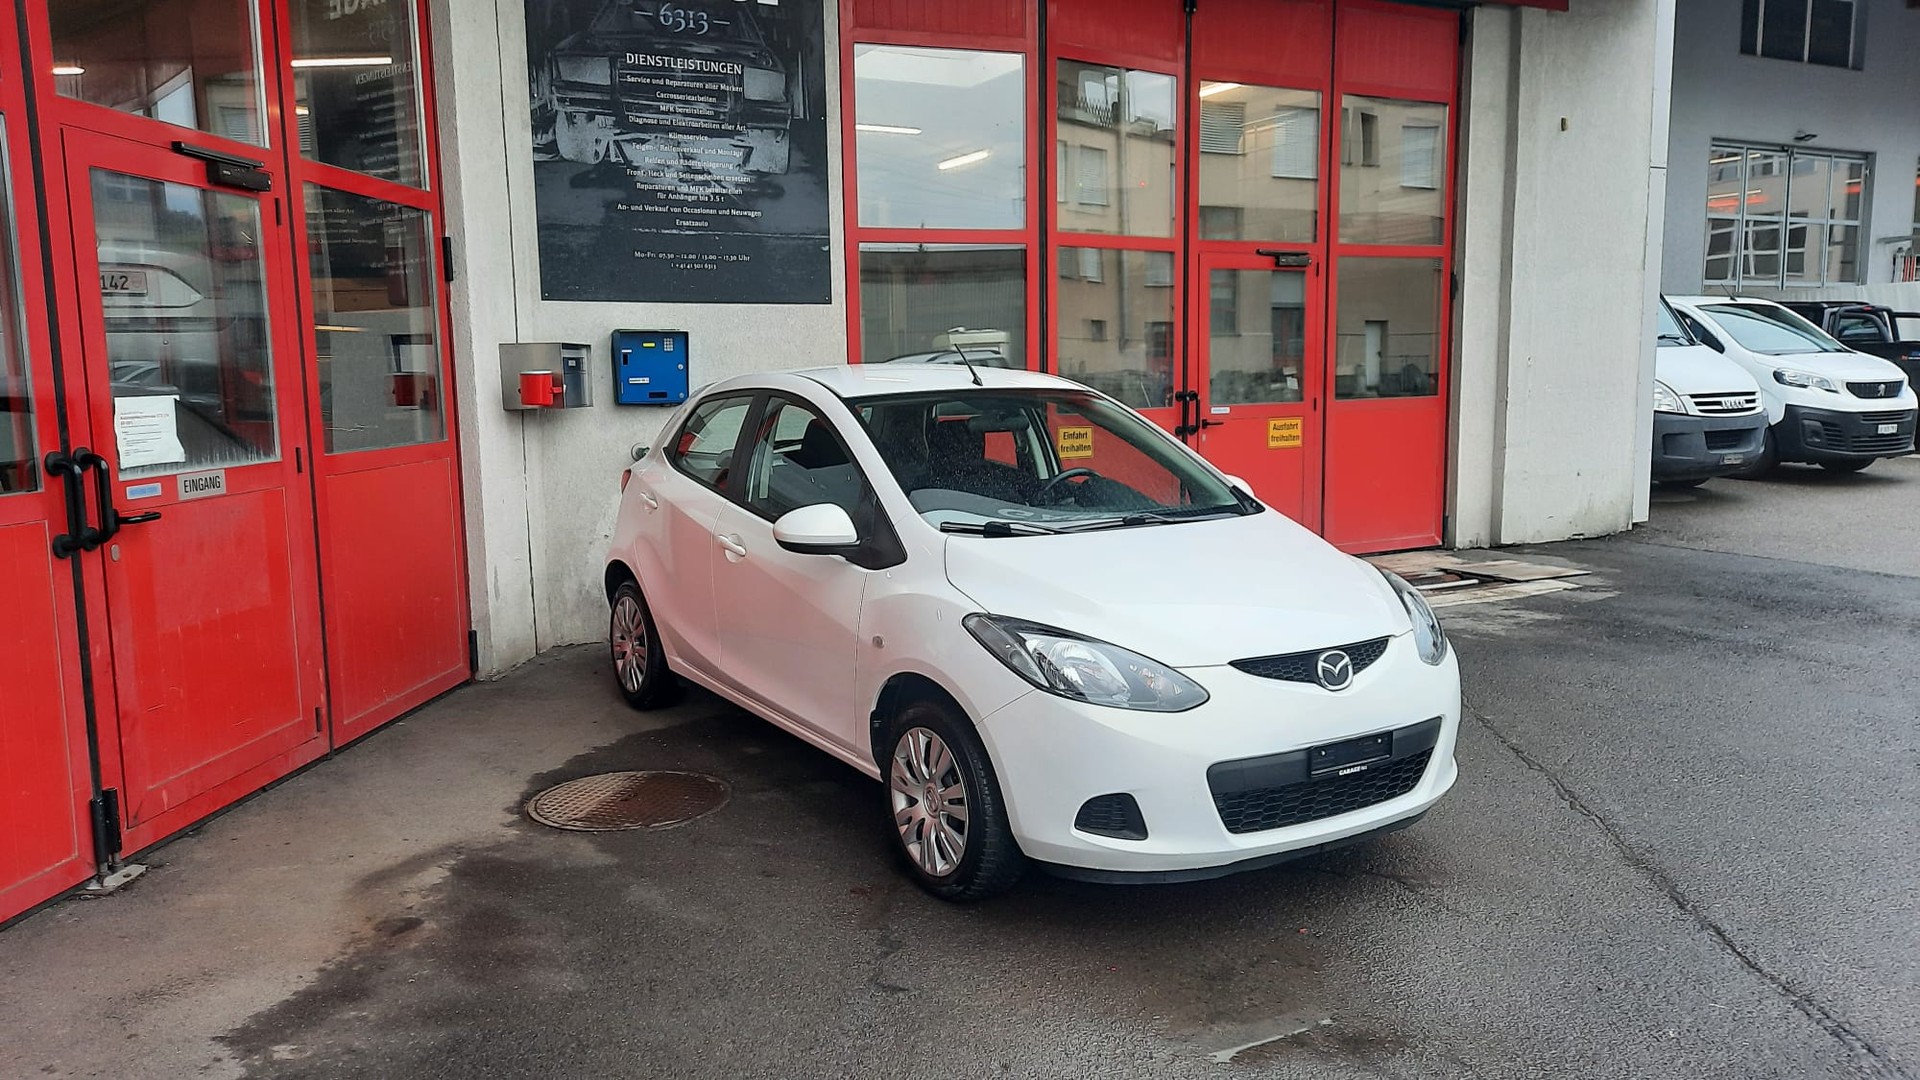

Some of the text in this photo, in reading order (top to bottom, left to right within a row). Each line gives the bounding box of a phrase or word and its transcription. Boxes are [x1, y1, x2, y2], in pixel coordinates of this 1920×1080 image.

[660, 3, 709, 34] 6313
[626, 53, 742, 75] DIENSTLEISTUNGEN
[626, 75, 651, 84] Service
[665, 79, 703, 88] Reparaturen
[705, 82, 719, 90] aller
[720, 84, 743, 92] Marken
[660, 104, 714, 116] MFK bereitstellen
[628, 115, 658, 124] Diagnose
[672, 119, 720, 129] Elektroarbeiten
[668, 132, 708, 141] Klimaservice
[648, 169, 664, 177] Heck
[636, 182, 676, 191] Reparaturen
[668, 193, 698, 202] Anhänger
[644, 204, 669, 212] Verkauf
[682, 206, 717, 215] Occasionen
[719, 208, 730, 216] und
[731, 209, 762, 218] Neuwagen
[675, 219, 709, 227] Ersatzauto
[738, 254, 750, 262] Uhr
[1272, 423, 1299, 431] Ausfahrt
[1063, 431, 1088, 440] Einfahrt
[1271, 434, 1300, 443] freihalten
[1060, 443, 1092, 453] freihalten
[183, 476, 221, 494] EINGANG
